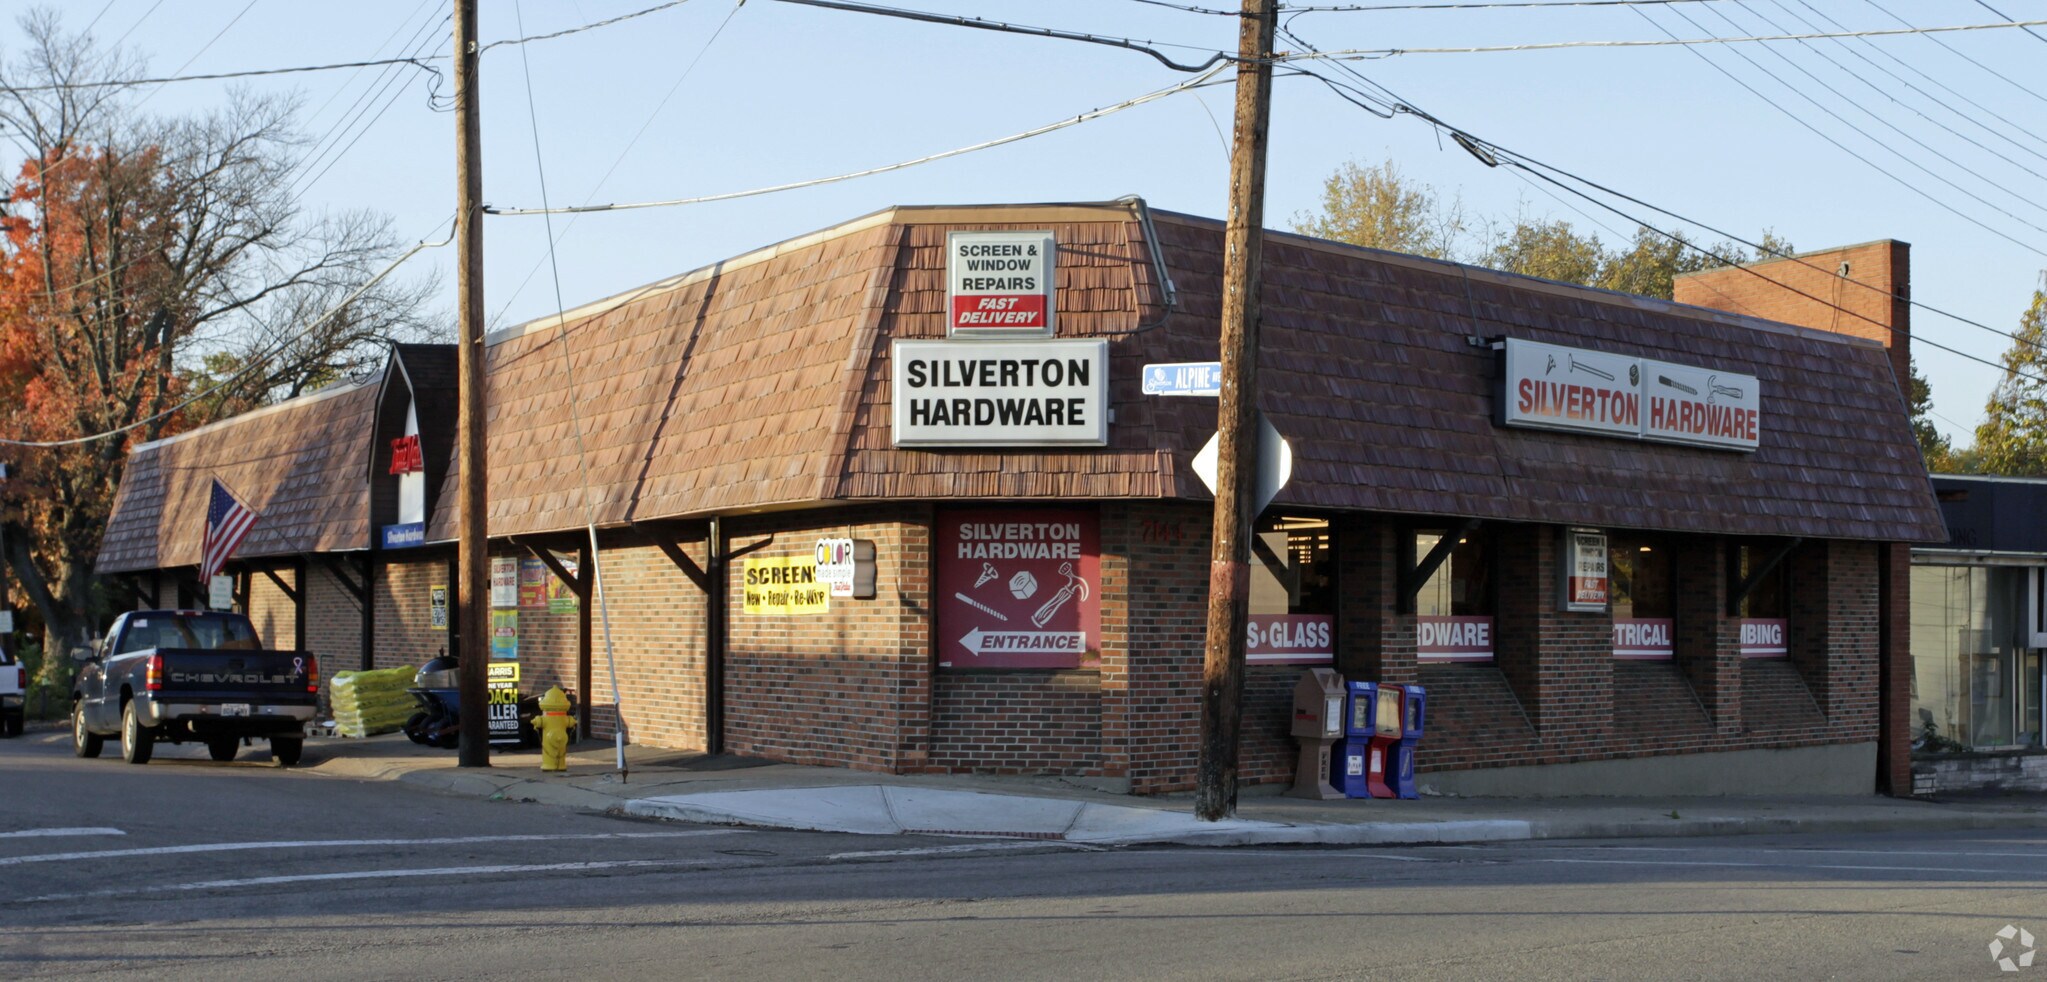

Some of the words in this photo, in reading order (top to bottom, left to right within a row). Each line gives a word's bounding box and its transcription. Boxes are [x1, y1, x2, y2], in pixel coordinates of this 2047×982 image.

[959, 244, 1022, 257] SCREEN
[1027, 244, 1038, 257] &
[967, 259, 1031, 271] WINDOW
[962, 277, 1036, 290] REPAIRS
[977, 297, 1018, 310] FAST
[958, 311, 1038, 324] DELIVERY
[907, 359, 1090, 387] SILVERTON
[1175, 367, 1211, 389] ALPINE
[909, 398, 1086, 426] HARDWARE
[1518, 377, 1639, 426] SILVERTON
[1650, 396, 1757, 441] HARDWARE
[959, 523, 1080, 540] SILVERTON
[817, 543, 851, 565] COLOR
[958, 542, 1081, 559] HARDWARE
[746, 591, 761, 606] New
[768, 589, 789, 607] Repair
[1612, 623, 1670, 646] TRICAL
[1740, 623, 1782, 645] MBING
[979, 635, 1081, 649] ENTRANCE
[171, 673, 299, 684] CHEVROLET
[488, 667, 513, 676] ARRIS
[1356, 682, 1370, 690] FREE
[488, 689, 518, 704] OACH
[488, 704, 518, 720] ILLER
[488, 720, 519, 730] ARANTEED
